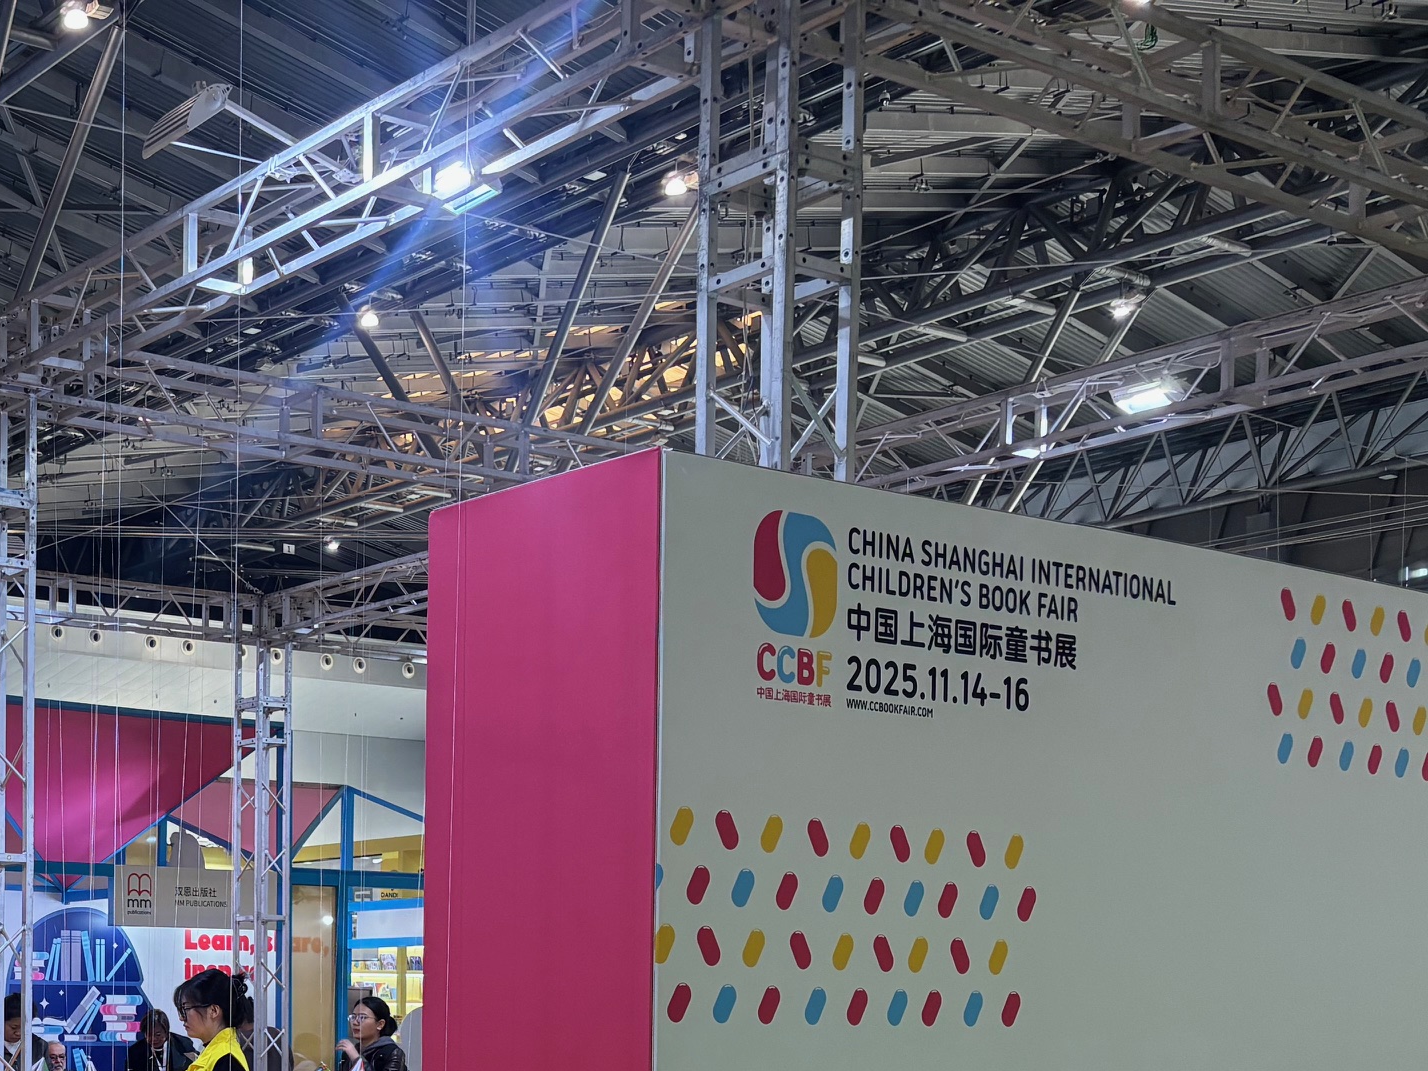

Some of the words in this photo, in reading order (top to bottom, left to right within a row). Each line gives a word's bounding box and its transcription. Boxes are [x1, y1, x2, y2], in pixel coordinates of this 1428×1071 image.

[847, 527, 915, 564] CHINA
[921, 539, 1024, 582] SHANGHAI
[1031, 557, 1177, 606] INTERNATIONAL
[847, 562, 972, 609] CHILDREN'S
[978, 583, 1030, 617] BOOK
[1037, 592, 1079, 623] FAIR
[847, 602, 1078, 671] 中国上海国际童书展
[756, 641, 833, 688] CCBF
[846, 655, 1030, 712] 2025.11.14-16
[756, 686, 833, 708] 中国上海国际童书展
[846, 698, 934, 719] WWW.CCBOOKFAIR.COM
[127, 898, 152, 909] mm
[185, 900, 229, 908] PUBLICATIONS
